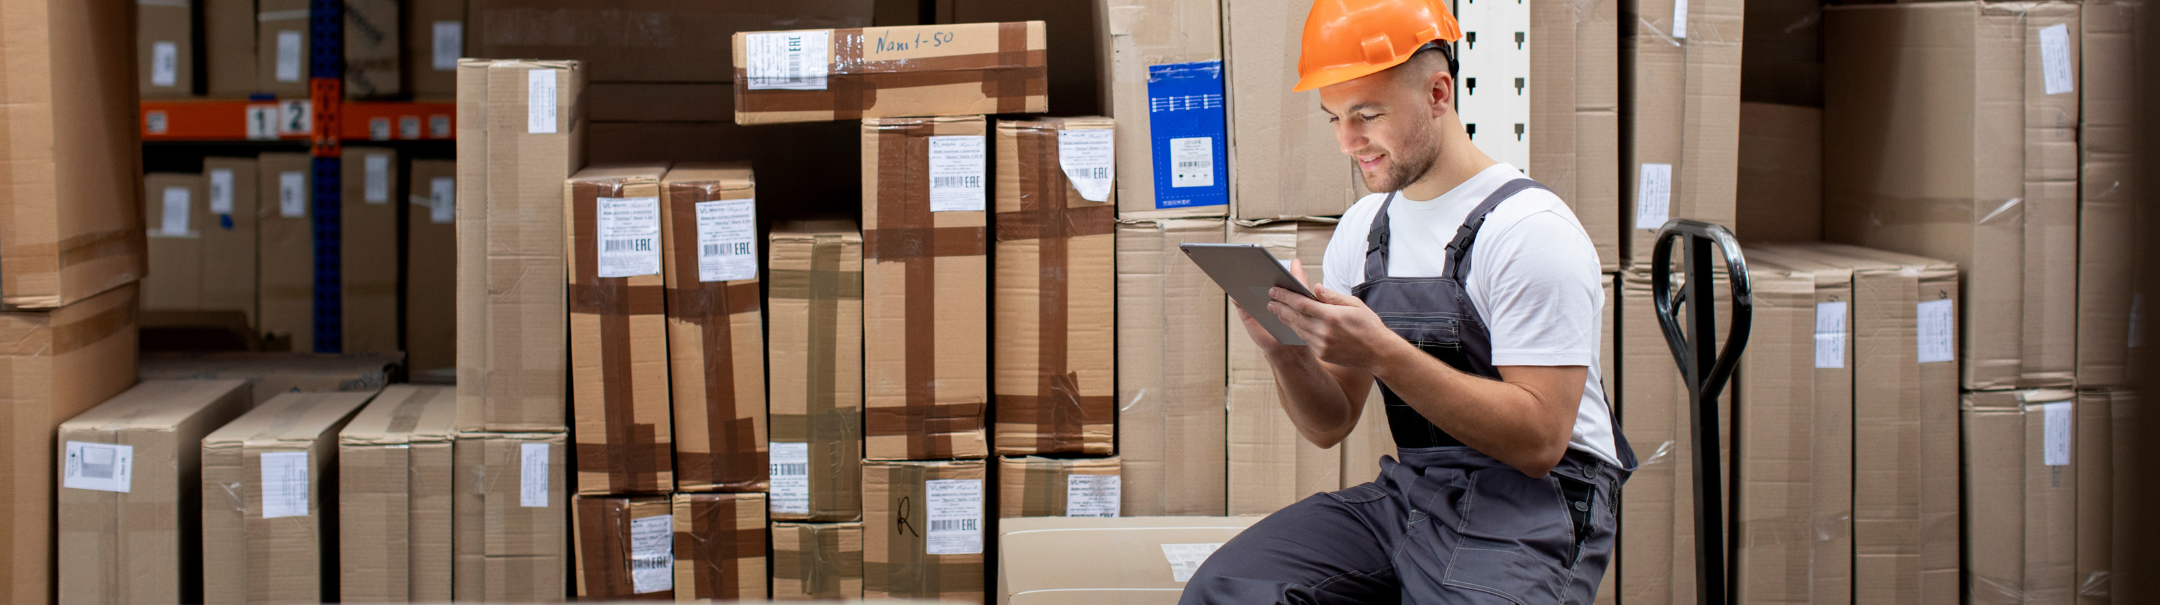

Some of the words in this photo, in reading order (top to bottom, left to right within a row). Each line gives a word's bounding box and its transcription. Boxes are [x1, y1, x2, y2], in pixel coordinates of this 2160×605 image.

[789, 36, 801, 51] EAC
[914, 31, 953, 49] 1-50
[254, 108, 265, 133] 1
[289, 103, 303, 130] 2
[1093, 167, 1108, 179] EAC
[965, 175, 980, 188] EAC
[635, 238, 651, 251] EAC
[735, 242, 751, 255] EAC
[897, 496, 919, 537] R
[962, 518, 977, 531] EAC
[652, 556, 667, 569] EAC
